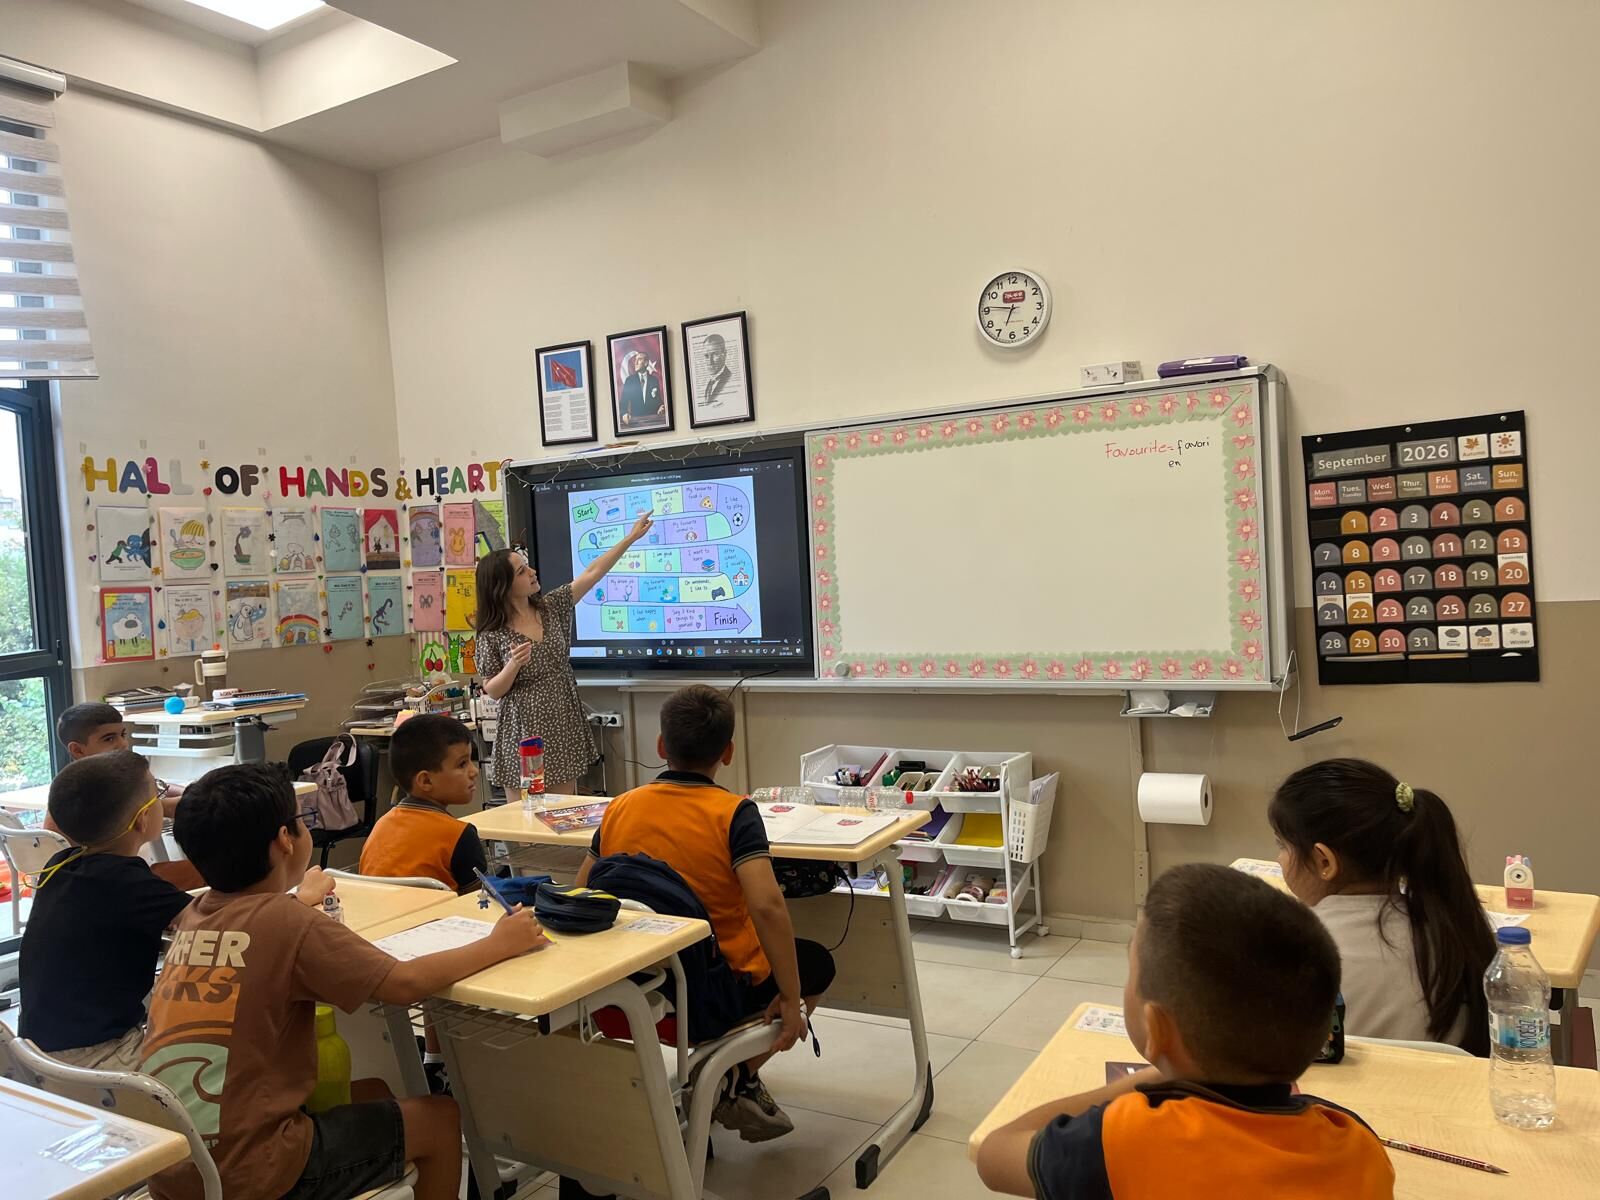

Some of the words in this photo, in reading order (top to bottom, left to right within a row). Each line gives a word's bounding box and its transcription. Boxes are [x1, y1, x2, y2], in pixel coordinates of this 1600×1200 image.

[1007, 276, 1018, 285] 12
[1023, 279, 1029, 287] 1
[996, 281, 1004, 290] 11
[987, 291, 998, 300] 10
[1031, 287, 1039, 296] 2
[983, 306, 991, 315] 9
[1035, 302, 1043, 310] 3
[987, 320, 994, 328] 8
[1031, 316, 1039, 324] 4
[995, 328, 1002, 337] 7
[1022, 326, 1030, 335] 5
[1008, 331, 1016, 340] 6
[1177, 437, 1210, 455] favori
[1318, 453, 1387, 470] September
[1403, 443, 1450, 462] 2026
[1168, 459, 1182, 468] en
[84, 456, 195, 495] HALL
[215, 464, 259, 497] OF
[279, 466, 389, 498] HANDS
[394, 477, 413, 500] &
[416, 461, 501, 497] HEART
[1342, 485, 1361, 493] Tues.
[1371, 482, 1392, 490] Wed.
[1402, 479, 1422, 487] Thur.
[1435, 475, 1451, 484] Fri.
[1466, 472, 1484, 481] Sat.
[1498, 470, 1519, 478] Sun.
[576, 506, 594, 518] Start
[1350, 518, 1356, 529] 1
[1379, 516, 1388, 527] 2
[1410, 512, 1418, 523] 3
[1439, 510, 1449, 521] 4
[1472, 507, 1481, 518] 5
[1505, 504, 1514, 515] 6
[1322, 550, 1330, 561] 7
[1351, 548, 1360, 558] 8
[1381, 546, 1390, 557] 9
[1407, 544, 1424, 555] 10
[1439, 541, 1454, 553] 11
[1470, 538, 1487, 549] 12
[1503, 537, 1521, 548] 13
[1321, 580, 1337, 590] 14
[1350, 578, 1366, 589] 15
[1379, 575, 1395, 586] 16
[1409, 574, 1426, 585] 17
[1439, 570, 1457, 582] 18
[1471, 569, 1489, 581] 19
[1505, 568, 1523, 579] 20
[1324, 610, 1338, 620] 21
[1352, 608, 1369, 619] 22
[1382, 606, 1398, 617] 23
[1411, 604, 1428, 615] 24
[1442, 603, 1459, 615] 25
[1474, 602, 1492, 613] 26
[1508, 601, 1525, 612] 27
[714, 612, 738, 625] Finish
[1325, 638, 1342, 649] 28
[1354, 638, 1370, 648] 29
[1384, 637, 1400, 648] 30
[1413, 636, 1429, 648] 31
